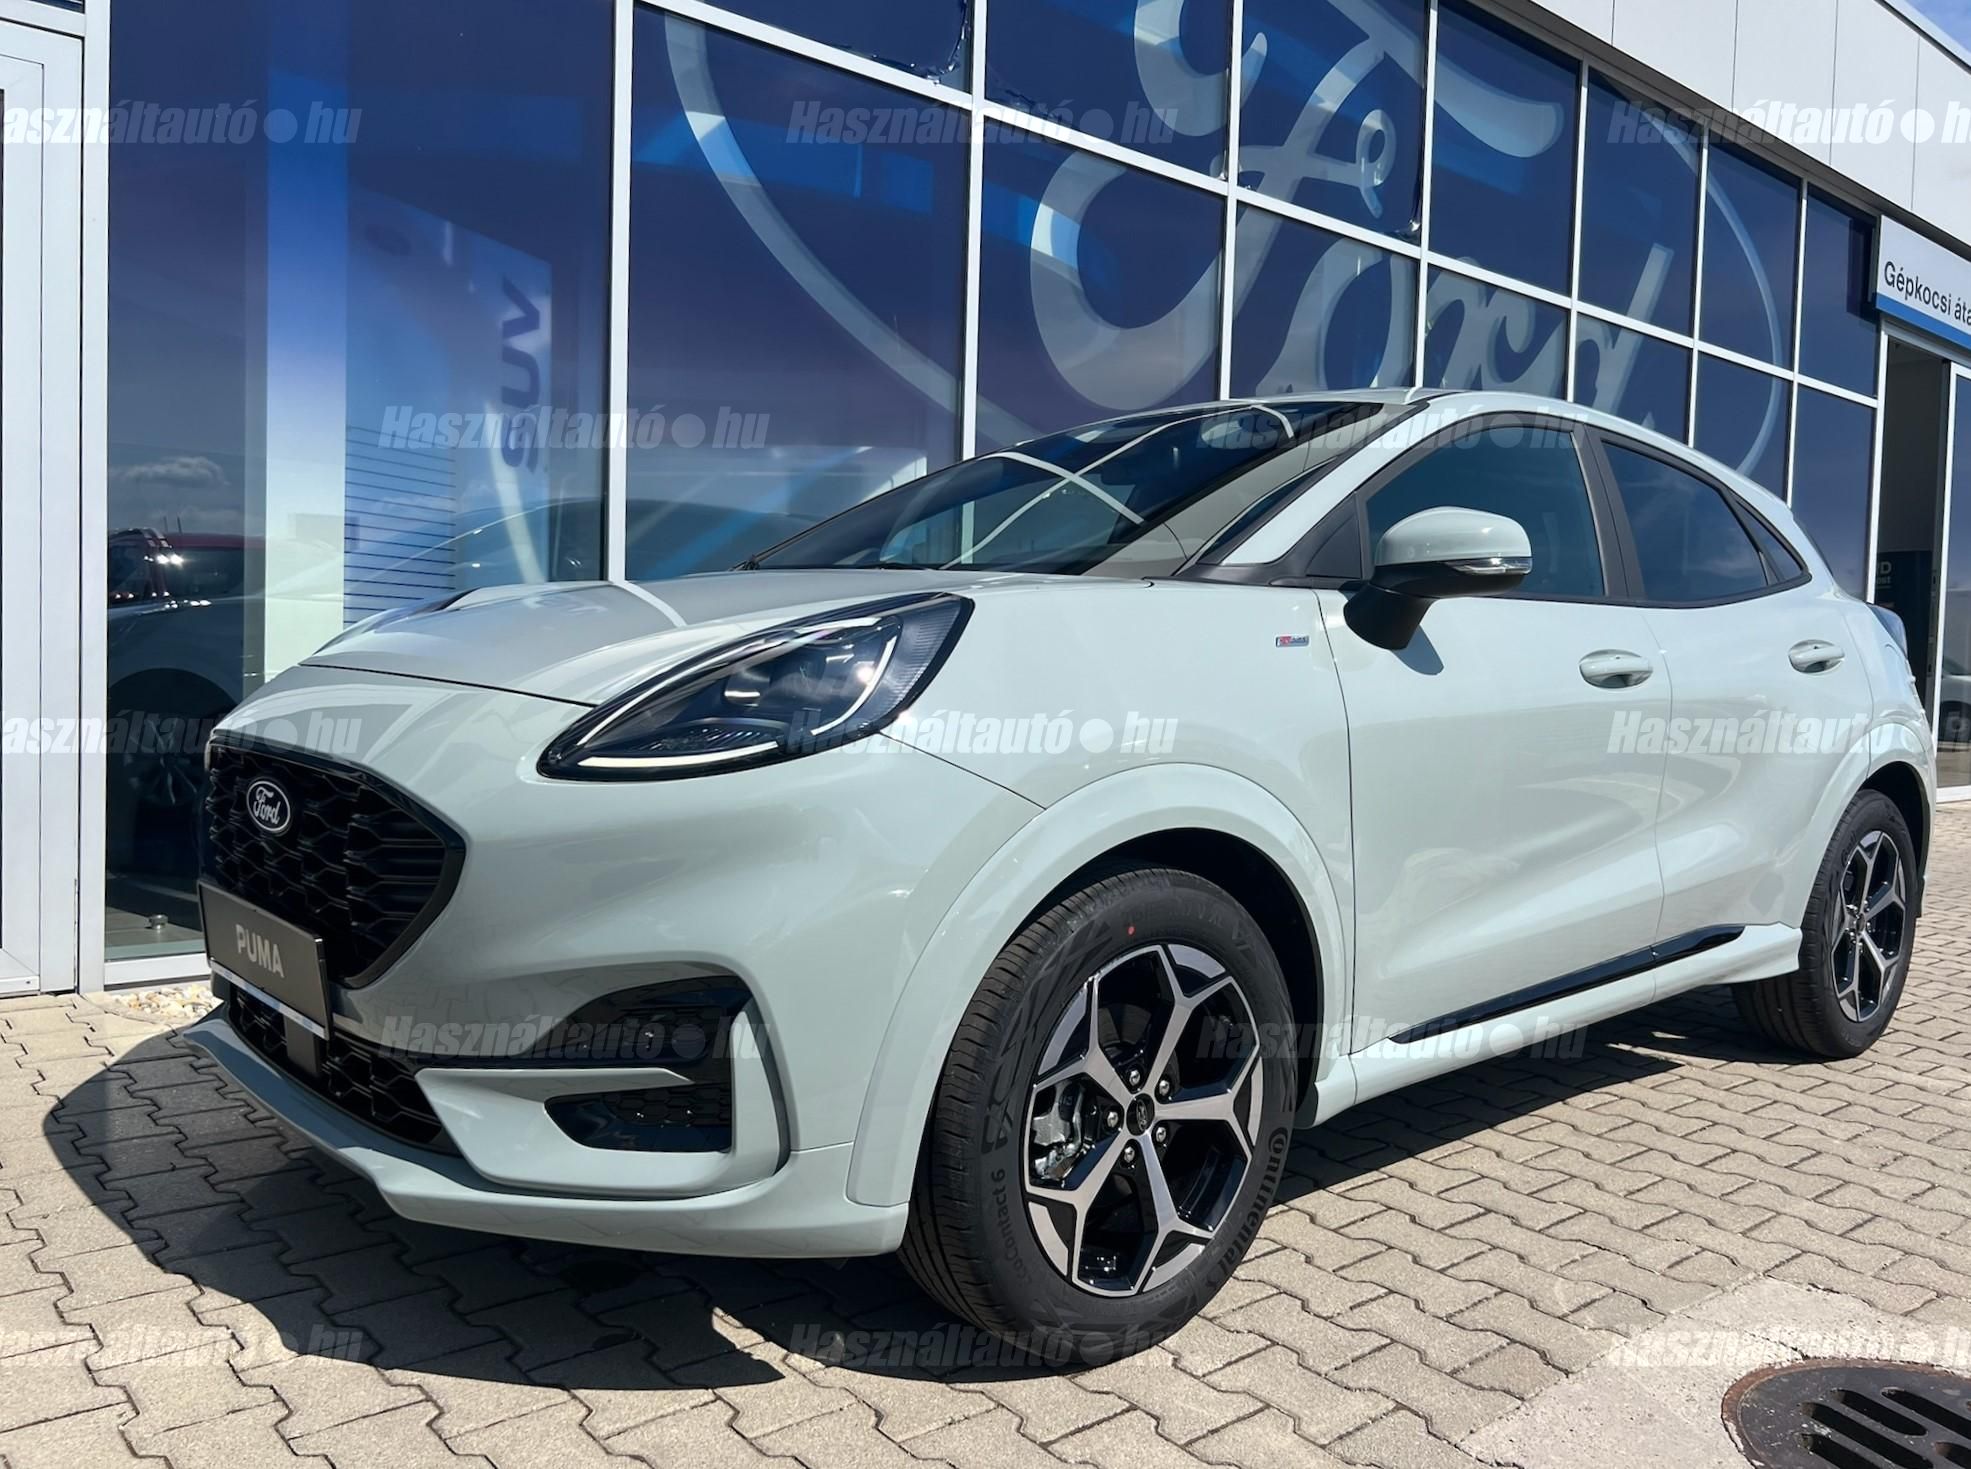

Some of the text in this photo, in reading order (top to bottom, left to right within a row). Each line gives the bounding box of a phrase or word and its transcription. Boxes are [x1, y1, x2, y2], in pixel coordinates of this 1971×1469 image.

[1884, 261, 1952, 316] Gépkocsi
[251, 784, 282, 826] Ford
[235, 923, 285, 979] PUMA
[1216, 1126, 1290, 1276] Continental
